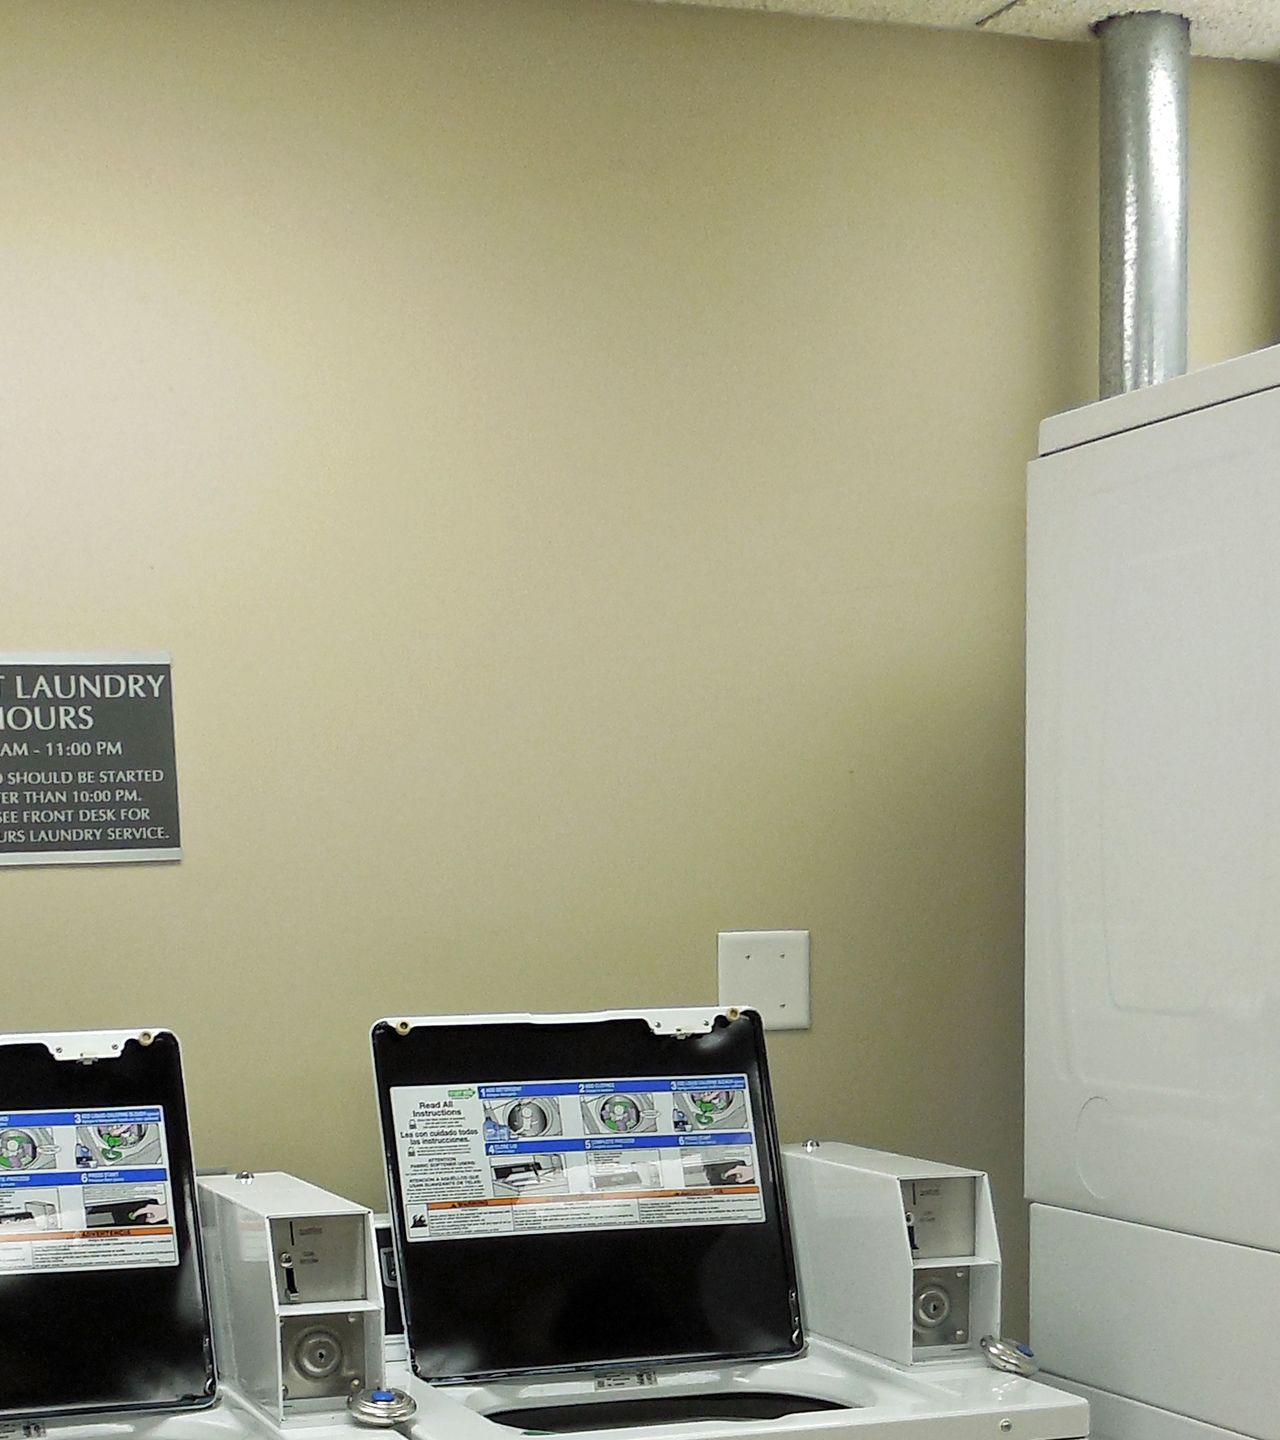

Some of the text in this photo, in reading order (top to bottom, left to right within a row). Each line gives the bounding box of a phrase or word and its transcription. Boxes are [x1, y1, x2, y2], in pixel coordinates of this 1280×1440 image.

[16, 674, 165, 700] LAUNDRY
[0, 742, 29, 757] AM
[46, 741, 92, 757] 11:00
[96, 741, 123, 756] PM
[7, 771, 73, 785] SHOULD
[77, 770, 95, 784] BE
[99, 769, 165, 783] STARTED
[23, 791, 67, 804] THAN
[72, 790, 111, 803] 10:00
[115, 789, 142, 802] PM.
[23, 809, 75, 823] FRONT
[78, 808, 117, 823] DESK
[120, 807, 151, 821] FOR
[29, 828, 103, 843] LAUNDRY
[107, 826, 170, 841] SERVICE.
[578, 1084, 585, 1093] 2
[670, 1081, 677, 1091] 3
[480, 1088, 486, 1098] 1
[412, 1109, 462, 1117] Instructions
[74, 1114, 81, 1124] 3
[584, 1139, 592, 1149] 5
[678, 1136, 685, 1146] 6
[488, 1144, 495, 1154] 4
[80, 1173, 88, 1183] 6
